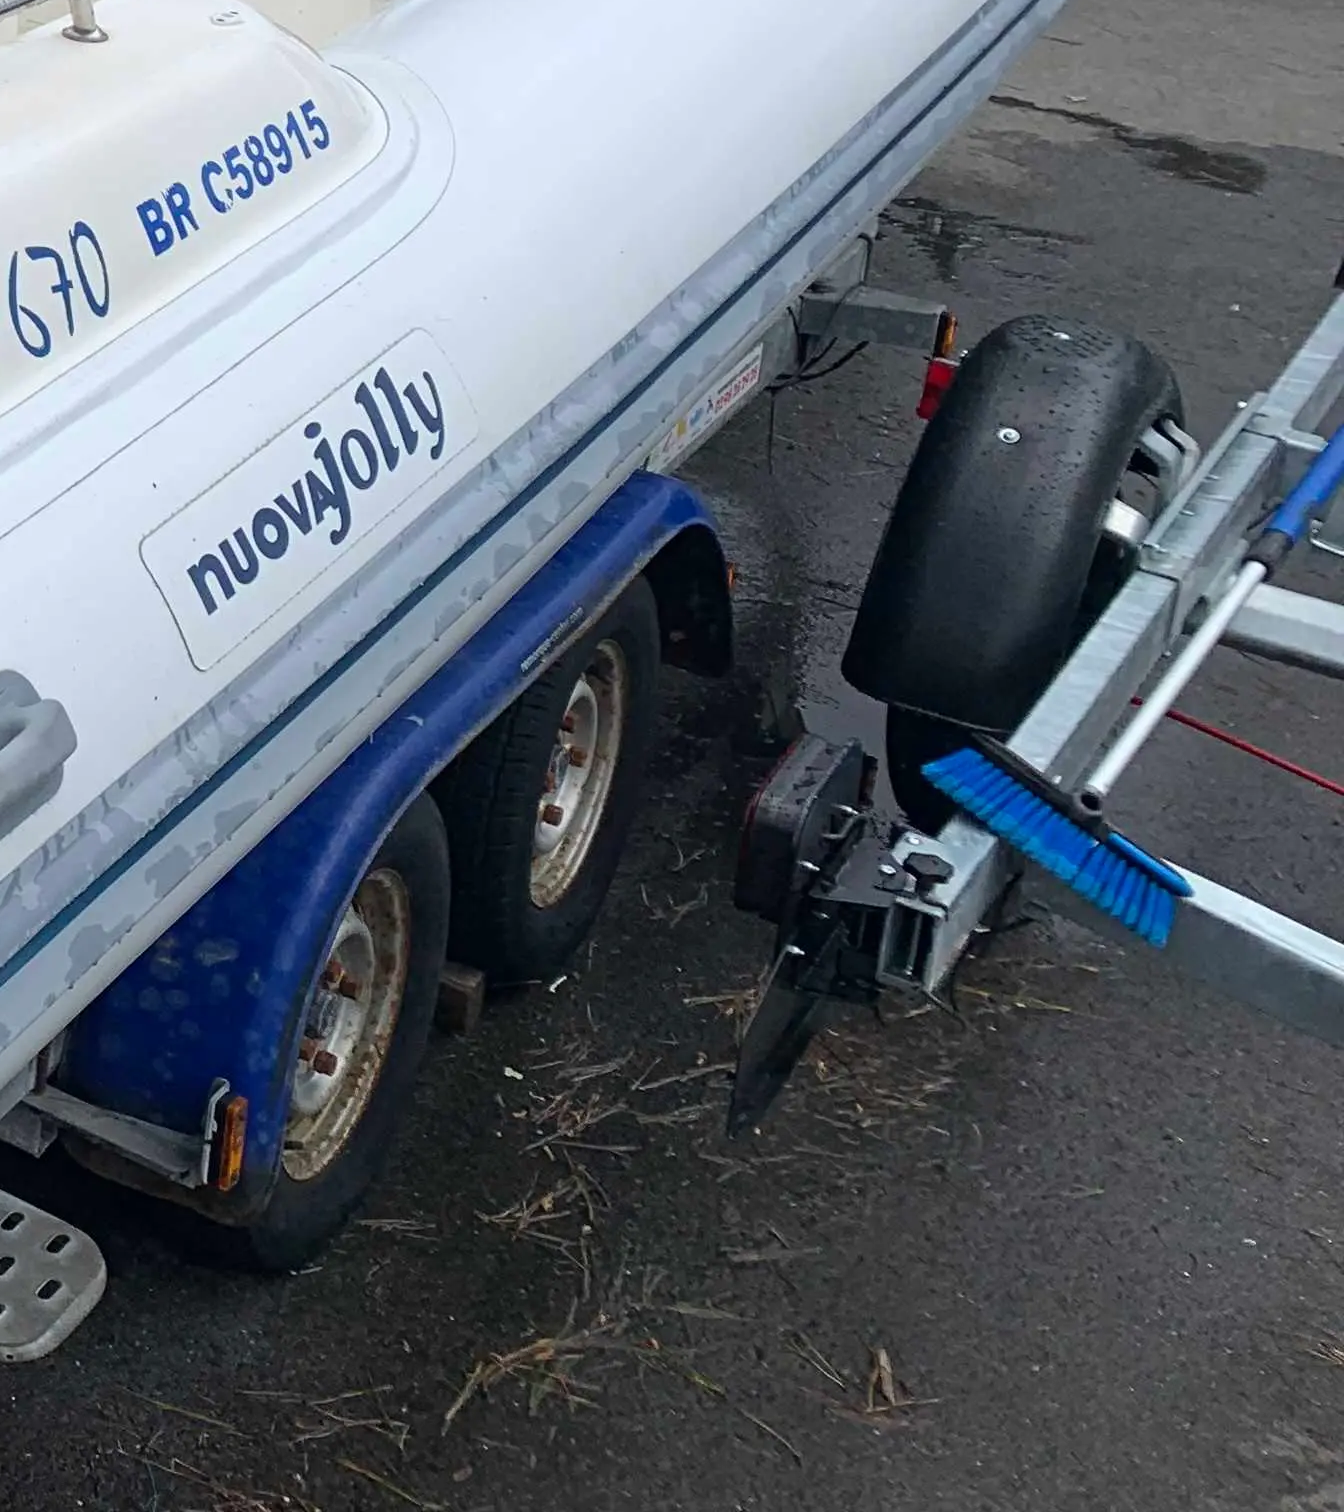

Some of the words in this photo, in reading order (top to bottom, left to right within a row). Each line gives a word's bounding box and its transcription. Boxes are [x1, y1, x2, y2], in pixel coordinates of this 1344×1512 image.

[8, 220, 110, 358] 670
[136, 181, 199, 257] BR
[201, 99, 331, 214] C58915
